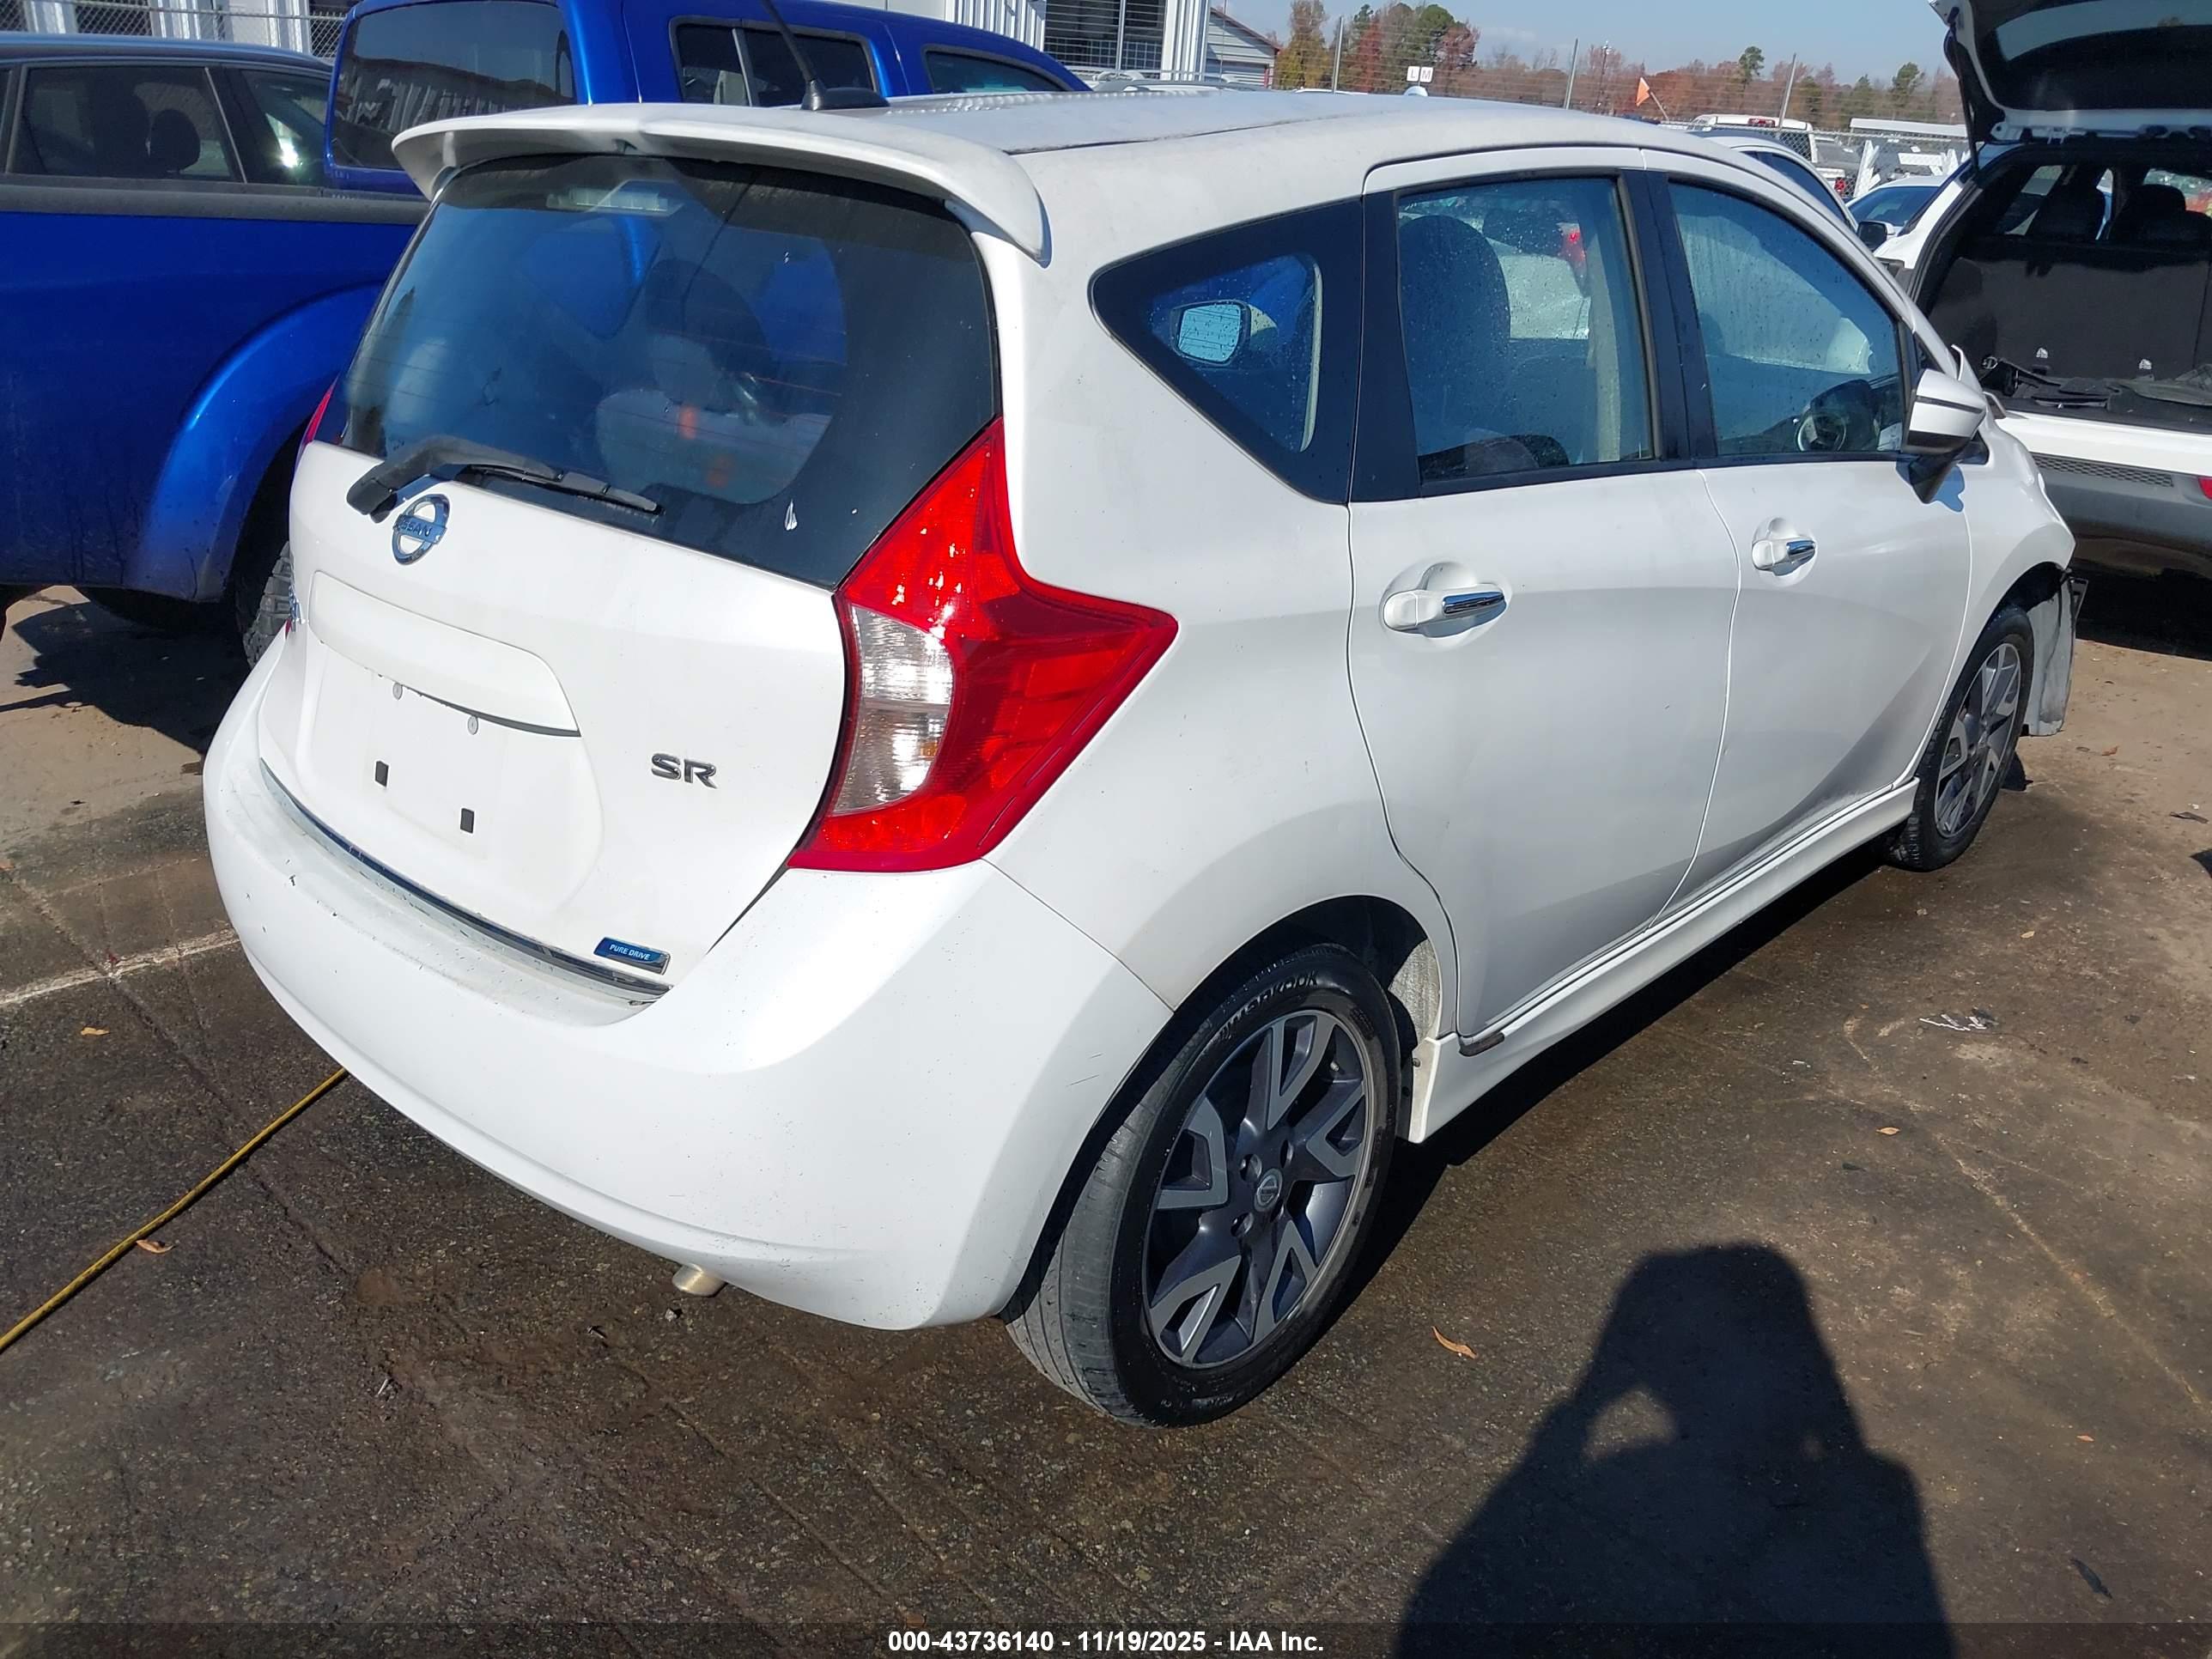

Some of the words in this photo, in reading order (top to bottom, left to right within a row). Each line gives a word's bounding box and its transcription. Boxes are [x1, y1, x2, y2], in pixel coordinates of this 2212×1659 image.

[651, 753, 717, 789] SR
[609, 944, 629, 955] PURE
[628, 949, 651, 961] DRIVE
